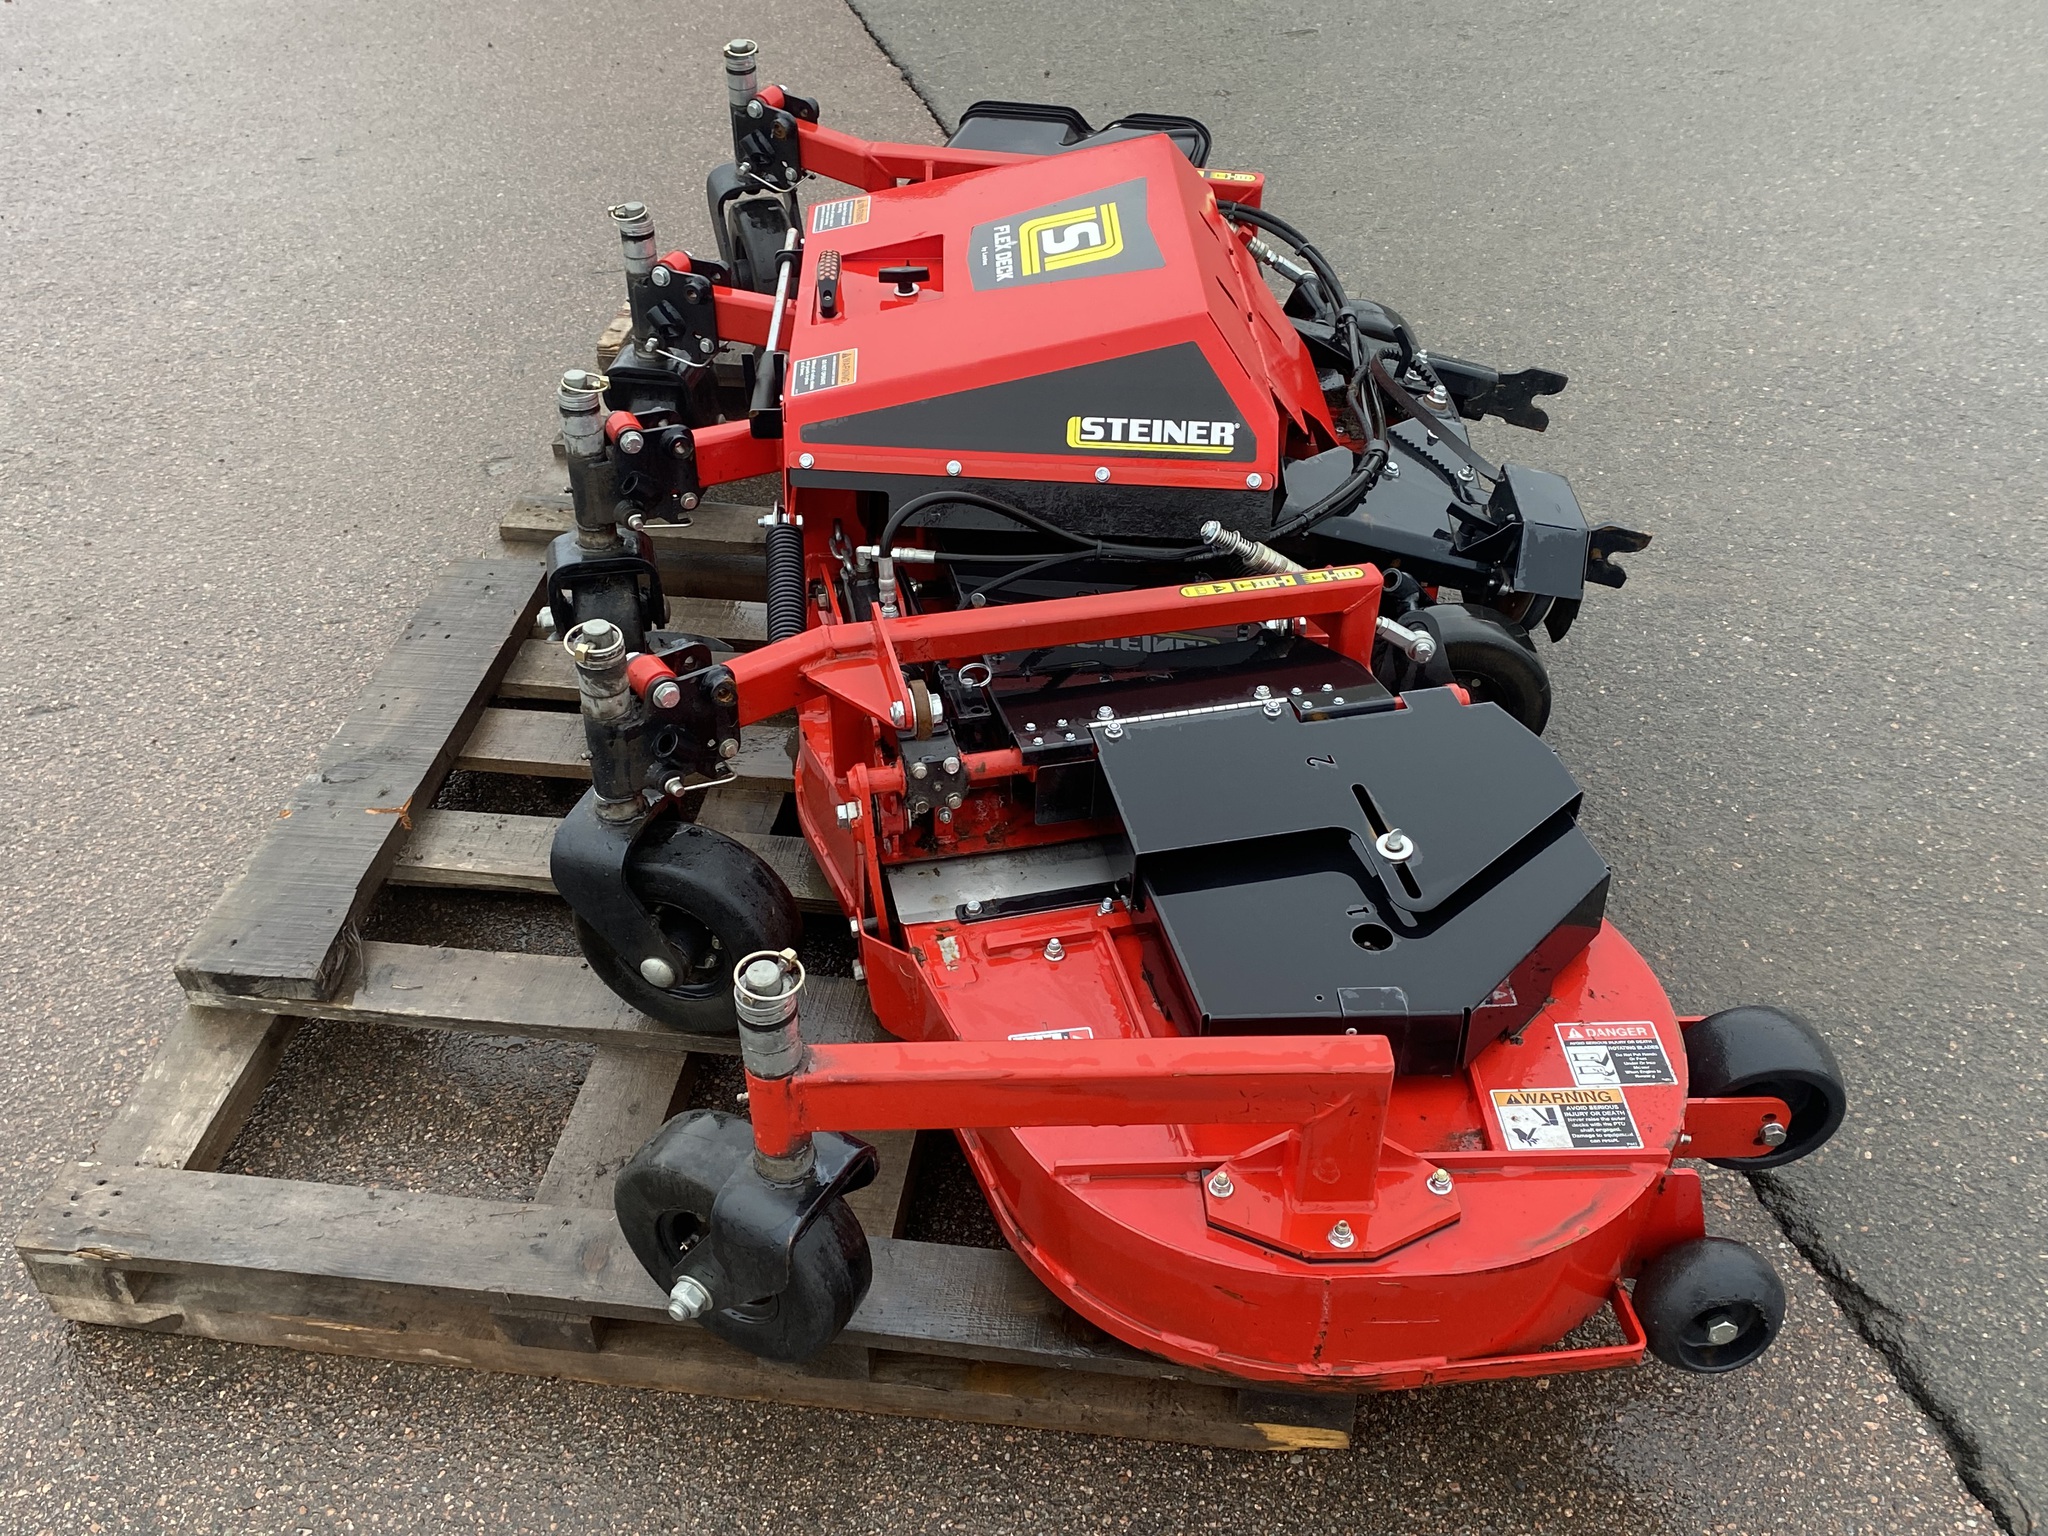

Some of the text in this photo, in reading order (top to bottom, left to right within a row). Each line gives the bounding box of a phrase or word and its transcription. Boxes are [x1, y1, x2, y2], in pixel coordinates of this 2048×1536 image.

[993, 224, 1014, 282] FLEX DECK
[1305, 754, 1336, 767] 2
[1585, 1027, 1647, 1037] DANGER
[1520, 1091, 1612, 1104] WARNING
